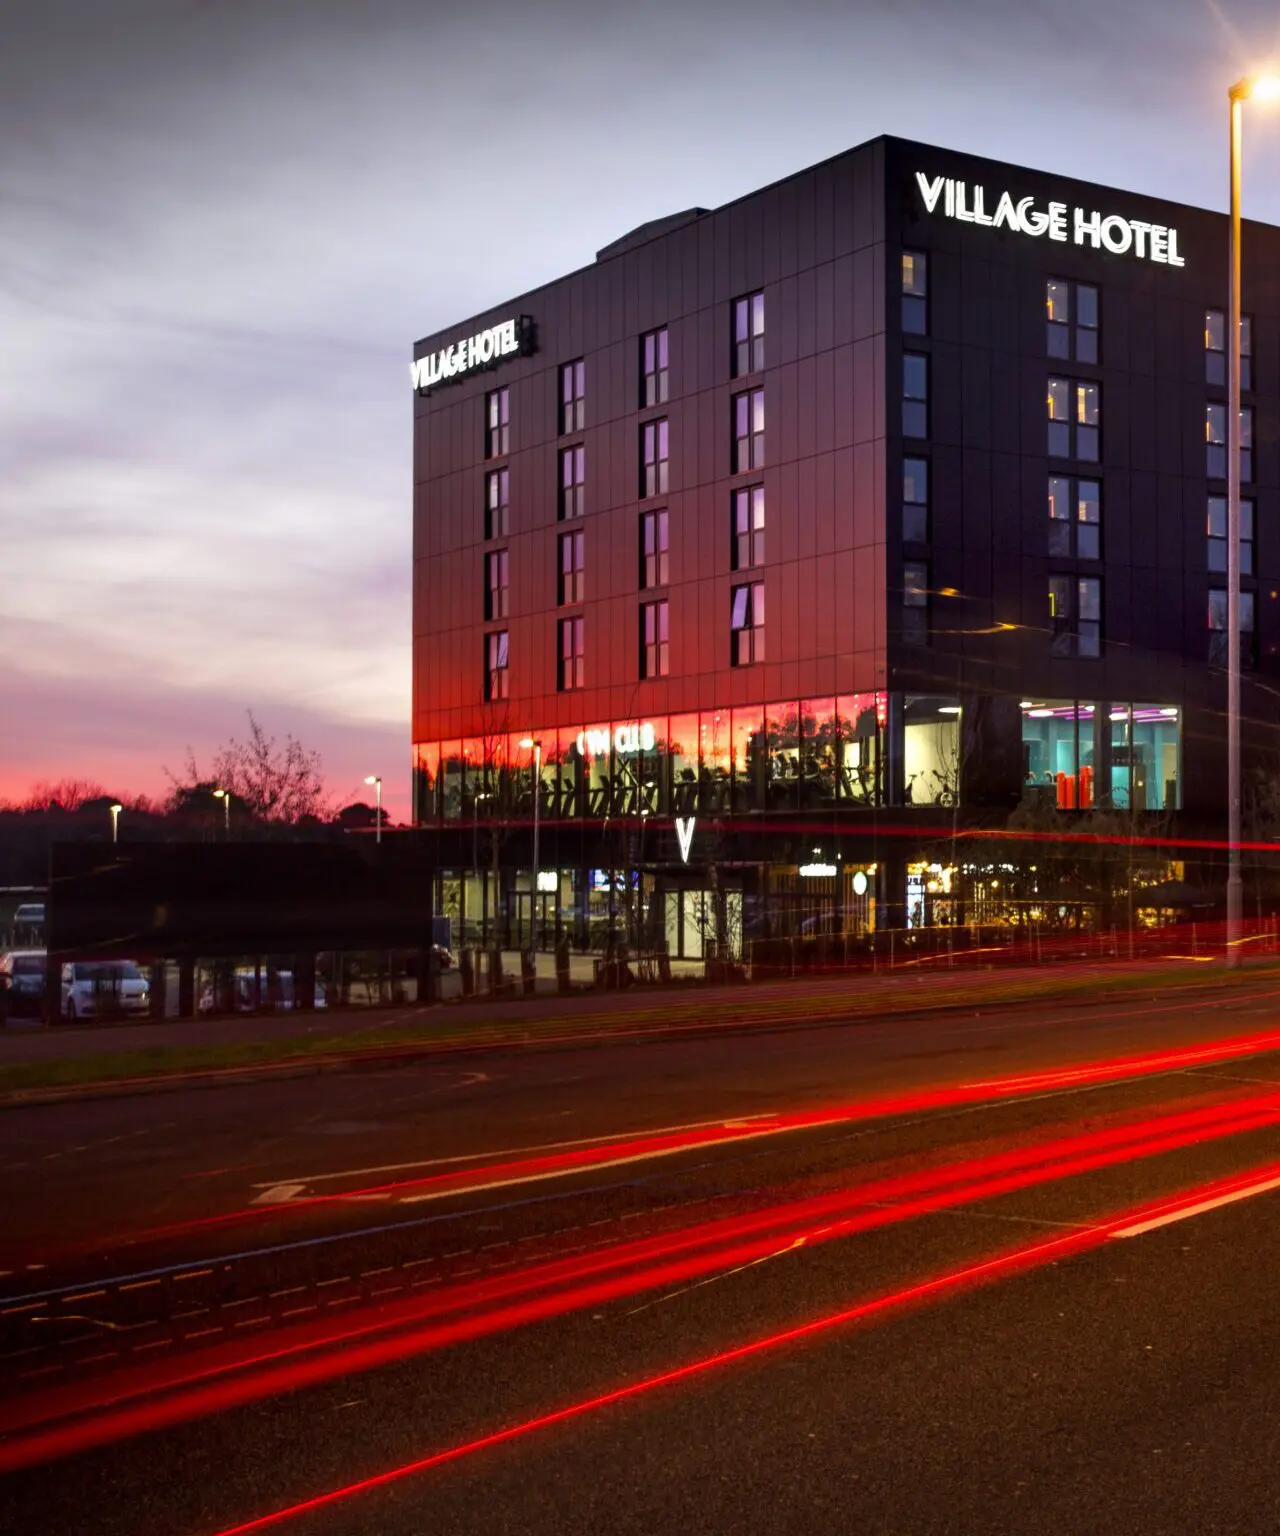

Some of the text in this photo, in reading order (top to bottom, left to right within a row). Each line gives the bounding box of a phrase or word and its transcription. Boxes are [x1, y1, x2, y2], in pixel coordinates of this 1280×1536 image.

[915, 171, 1186, 267] VILLAGE HOTEL
[410, 318, 519, 391] VILLAGE HOTEL
[675, 816, 696, 863] V
